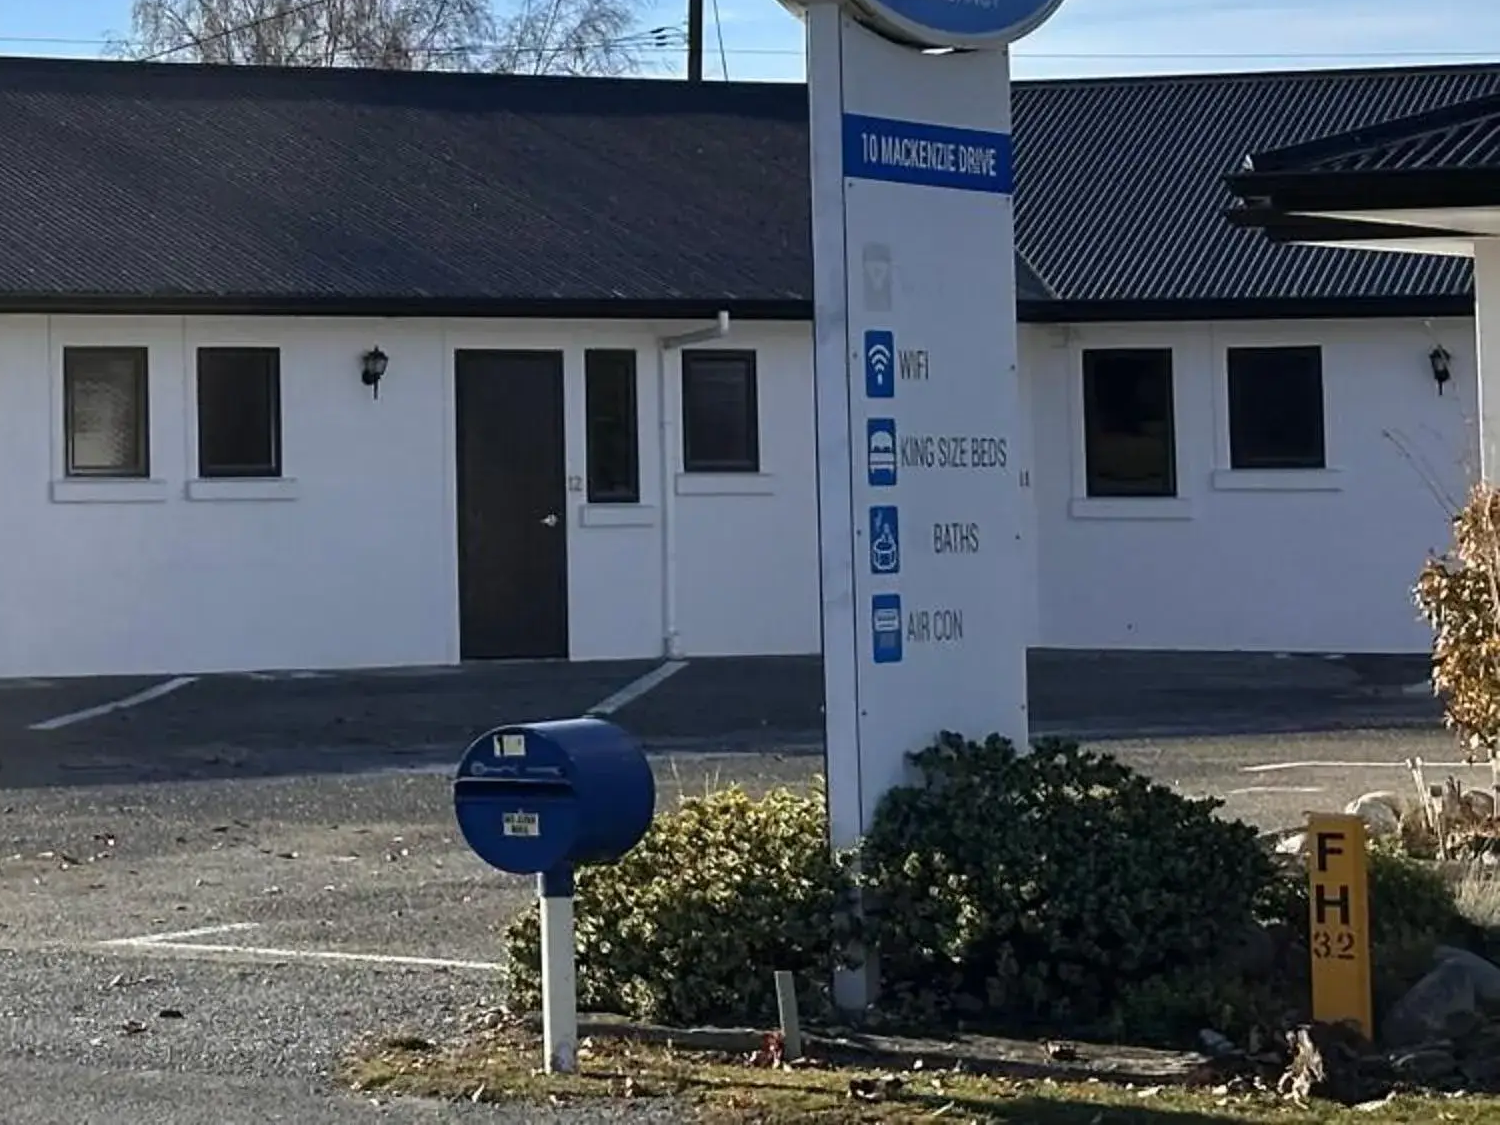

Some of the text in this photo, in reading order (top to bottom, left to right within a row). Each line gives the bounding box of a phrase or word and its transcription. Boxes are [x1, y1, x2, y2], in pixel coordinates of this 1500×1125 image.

[861, 132, 997, 177] 10 MACKENZIE DRIVE
[898, 350, 929, 380] WIFI
[901, 436, 1007, 468] KING SIZE BEDS
[933, 522, 980, 554] BATHS
[906, 609, 963, 642] AIR CON
[1313, 932, 1356, 960] 32
